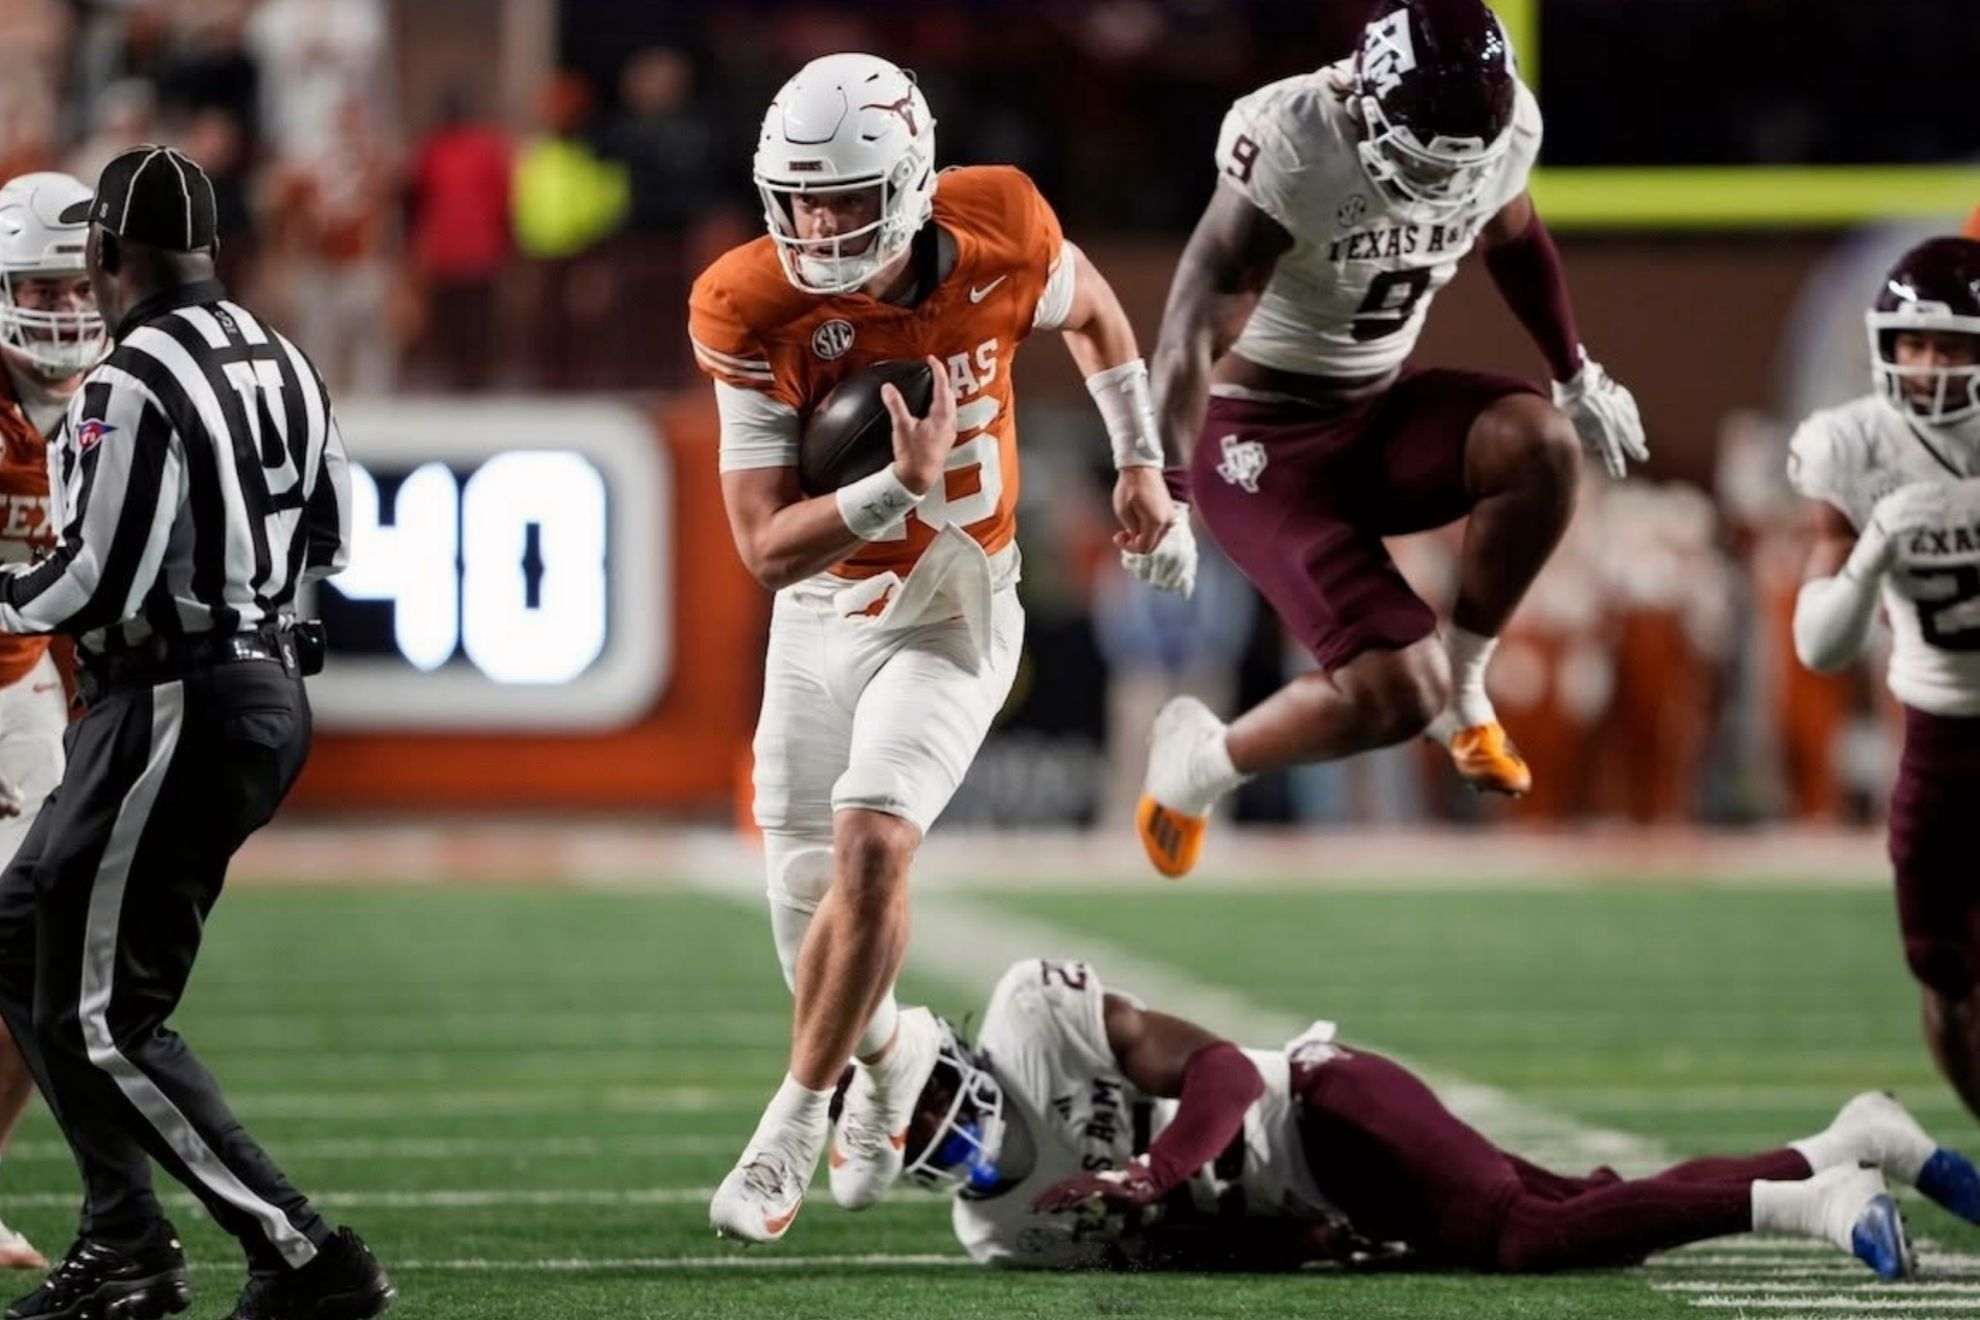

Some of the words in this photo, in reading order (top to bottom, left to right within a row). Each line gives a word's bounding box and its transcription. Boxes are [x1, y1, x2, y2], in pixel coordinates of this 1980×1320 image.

[1227, 133, 1261, 185] 9
[1329, 224, 1418, 262] TEXAS
[1351, 265, 1431, 342] 9
[813, 321, 853, 357] SEC
[324, 450, 607, 685] 40
